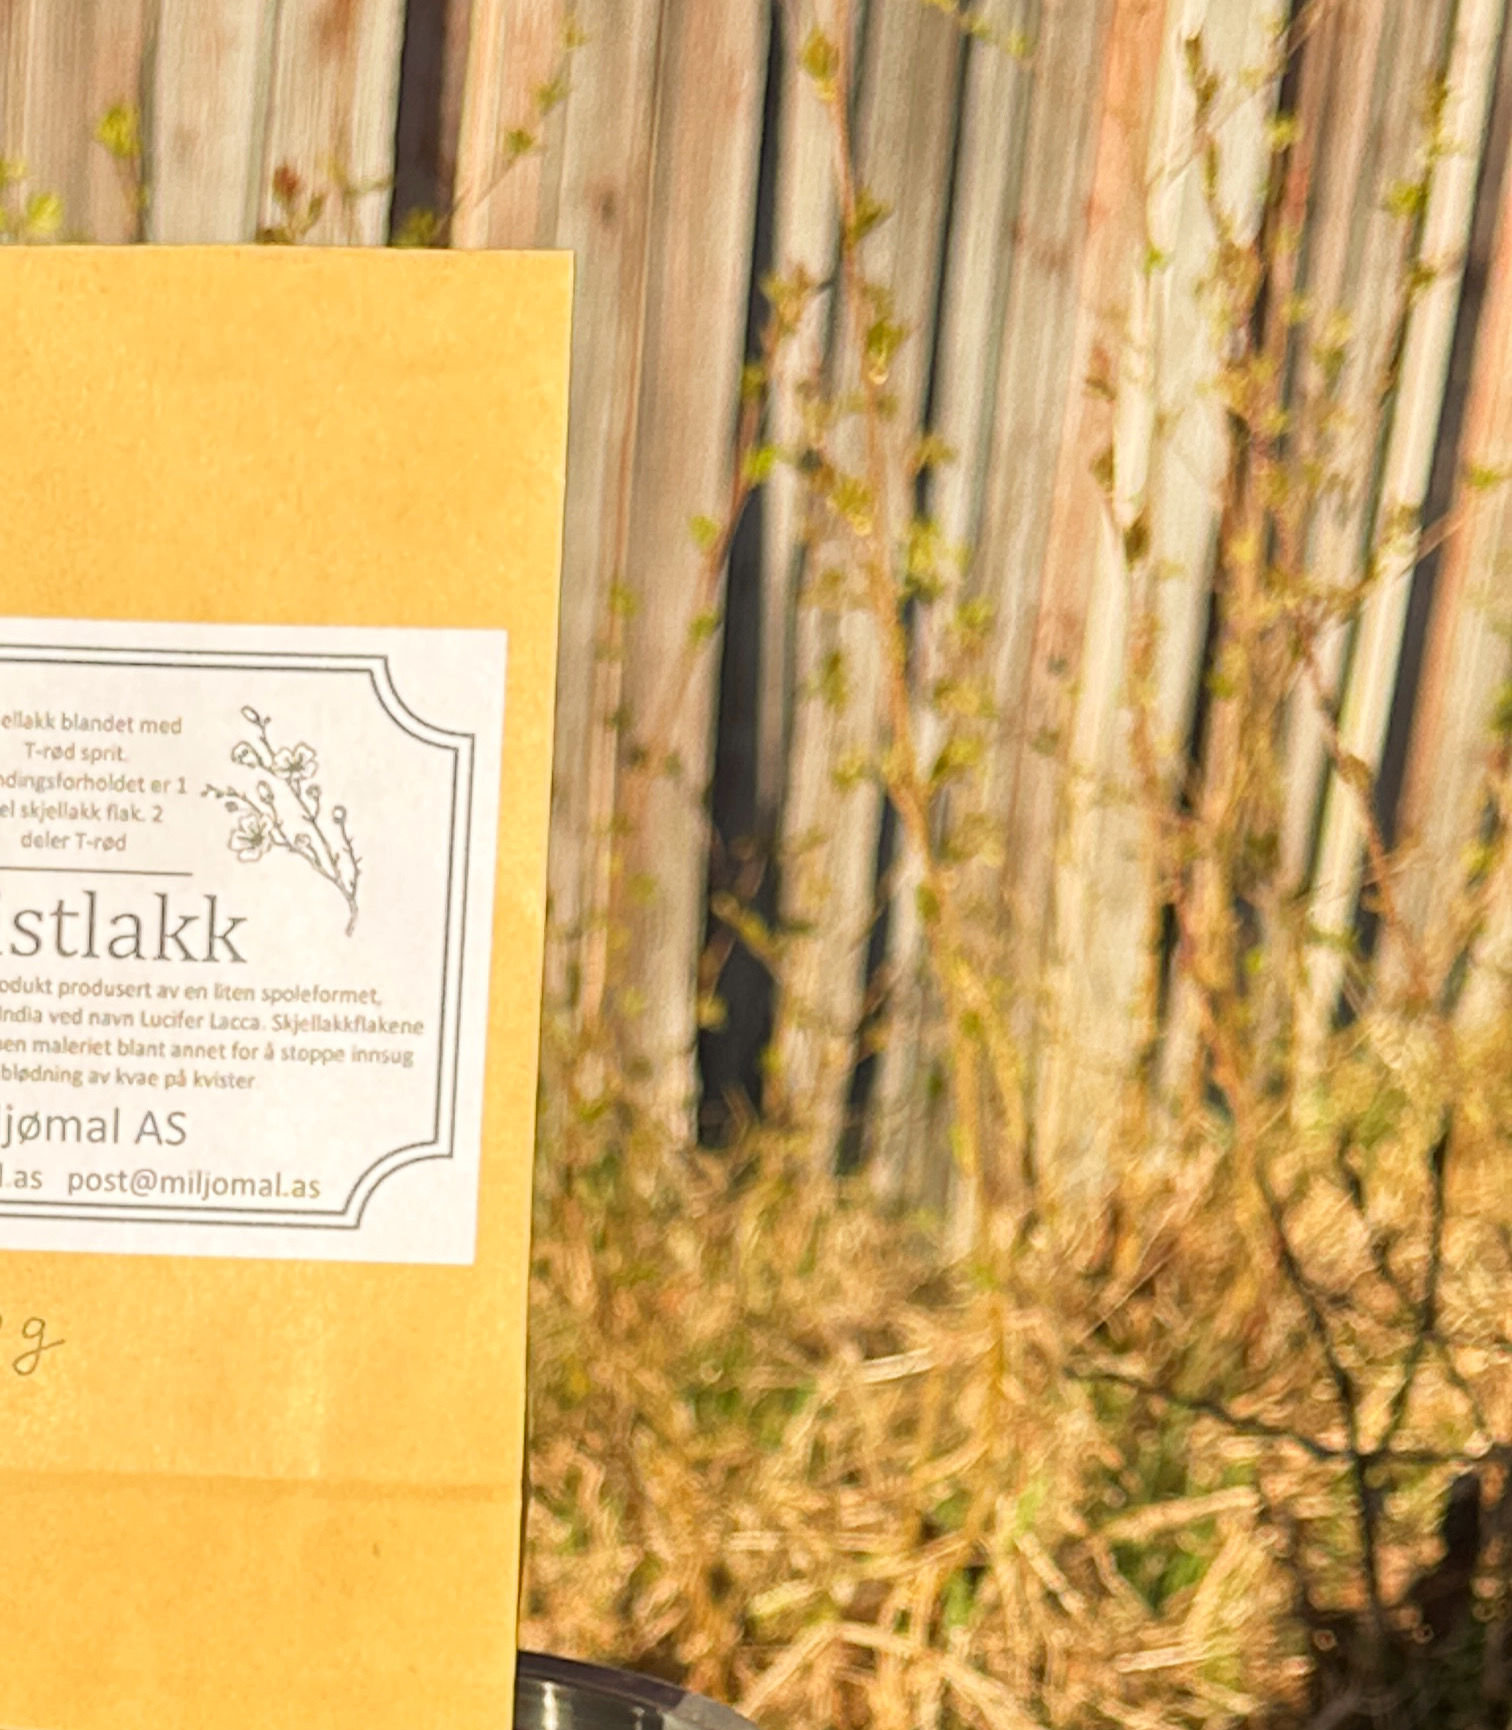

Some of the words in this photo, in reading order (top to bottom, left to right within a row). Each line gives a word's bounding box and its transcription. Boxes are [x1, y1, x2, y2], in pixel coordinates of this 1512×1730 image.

[62, 712, 134, 733] blandet
[140, 716, 182, 734] med
[25, 742, 75, 760] T-rød
[151, 779, 171, 793] er
[178, 777, 187, 794] 1
[21, 801, 100, 823] skjellakk
[152, 805, 164, 823] 2
[21, 831, 69, 849] deler
[76, 832, 127, 851] T-rød
[58, 977, 151, 998] produsert
[157, 984, 179, 998] av
[185, 985, 207, 999] en
[214, 982, 255, 1001] liten
[262, 984, 382, 1006] spoleformet,
[49, 1007, 83, 1025] ved
[89, 1012, 134, 1026] navn
[141, 1010, 204, 1029] Lucifer
[272, 1013, 424, 1035] Skjellakkflakene
[33, 1036, 112, 1056] maleriet
[118, 1038, 165, 1057] blant
[171, 1041, 225, 1059] annet
[232, 1041, 259, 1060] for
[264, 1042, 274, 1061] å
[281, 1045, 345, 1065] stoppe
[351, 1045, 414, 1068] innsug
[88, 1070, 110, 1084] av
[116, 1067, 158, 1087] kvae
[165, 1069, 186, 1090] på
[193, 1070, 255, 1089] kvister
[135, 1109, 188, 1146] AS
[68, 1167, 321, 1200] post@miljomal.as
[12, 1316, 66, 1376] g
